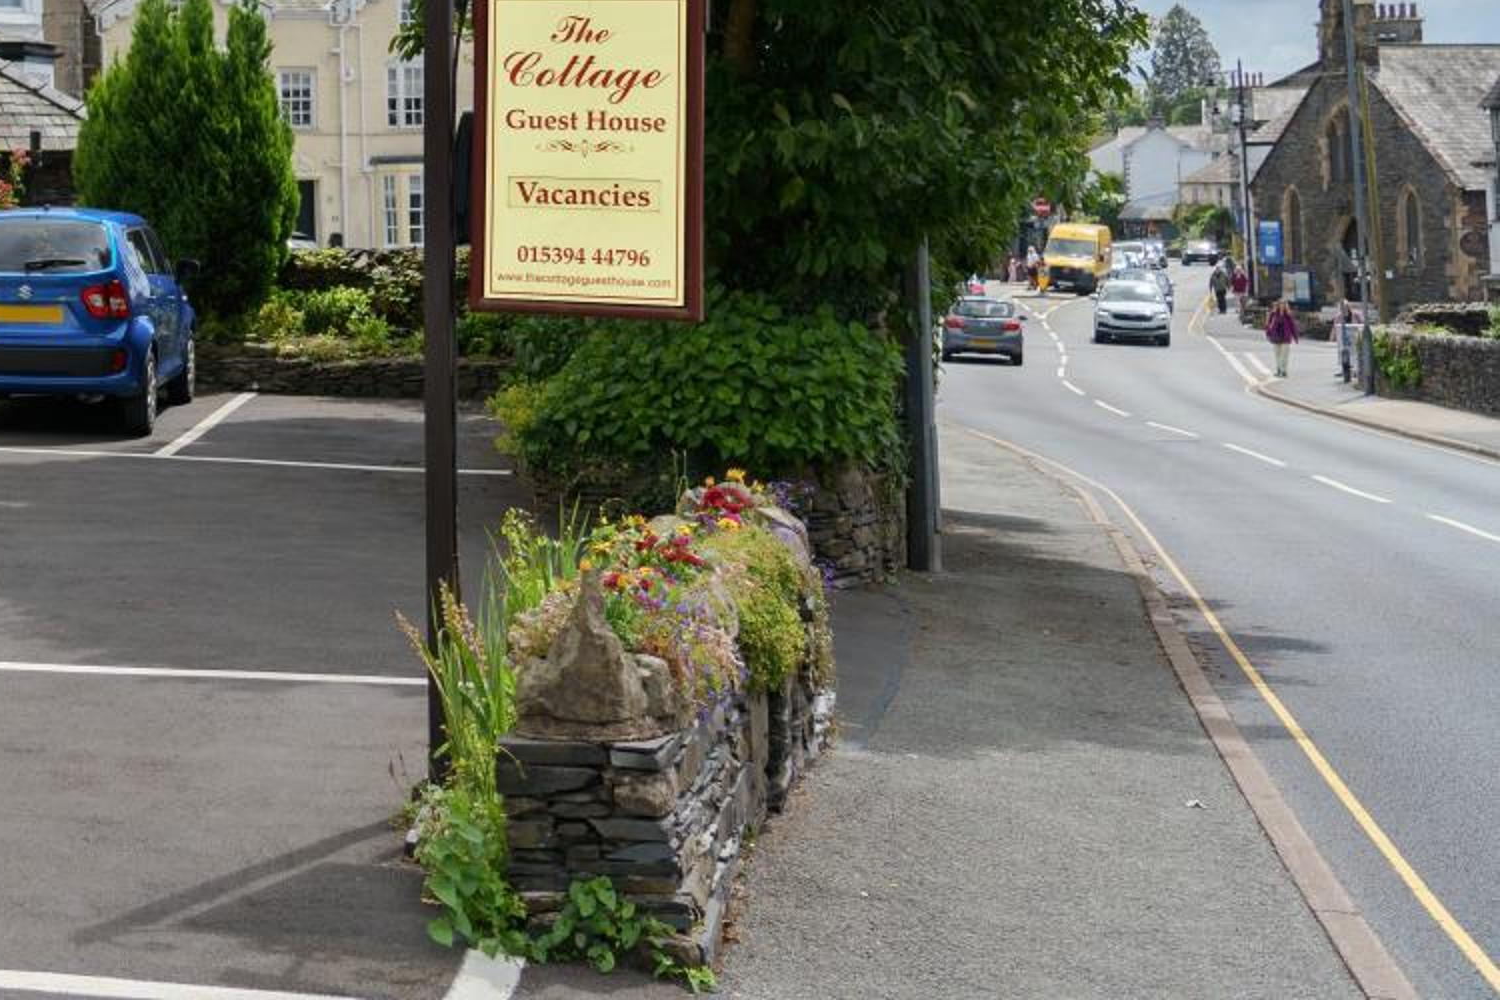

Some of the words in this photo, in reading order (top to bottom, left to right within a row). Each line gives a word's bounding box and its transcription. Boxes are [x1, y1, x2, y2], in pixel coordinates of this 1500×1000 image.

[550, 14, 613, 44] The
[502, 50, 669, 105] Cottage
[504, 108, 579, 132] Guest
[586, 110, 667, 133] House
[515, 180, 651, 208] Vacancies
[516, 245, 586, 265] 015394
[591, 248, 651, 267] 44796
